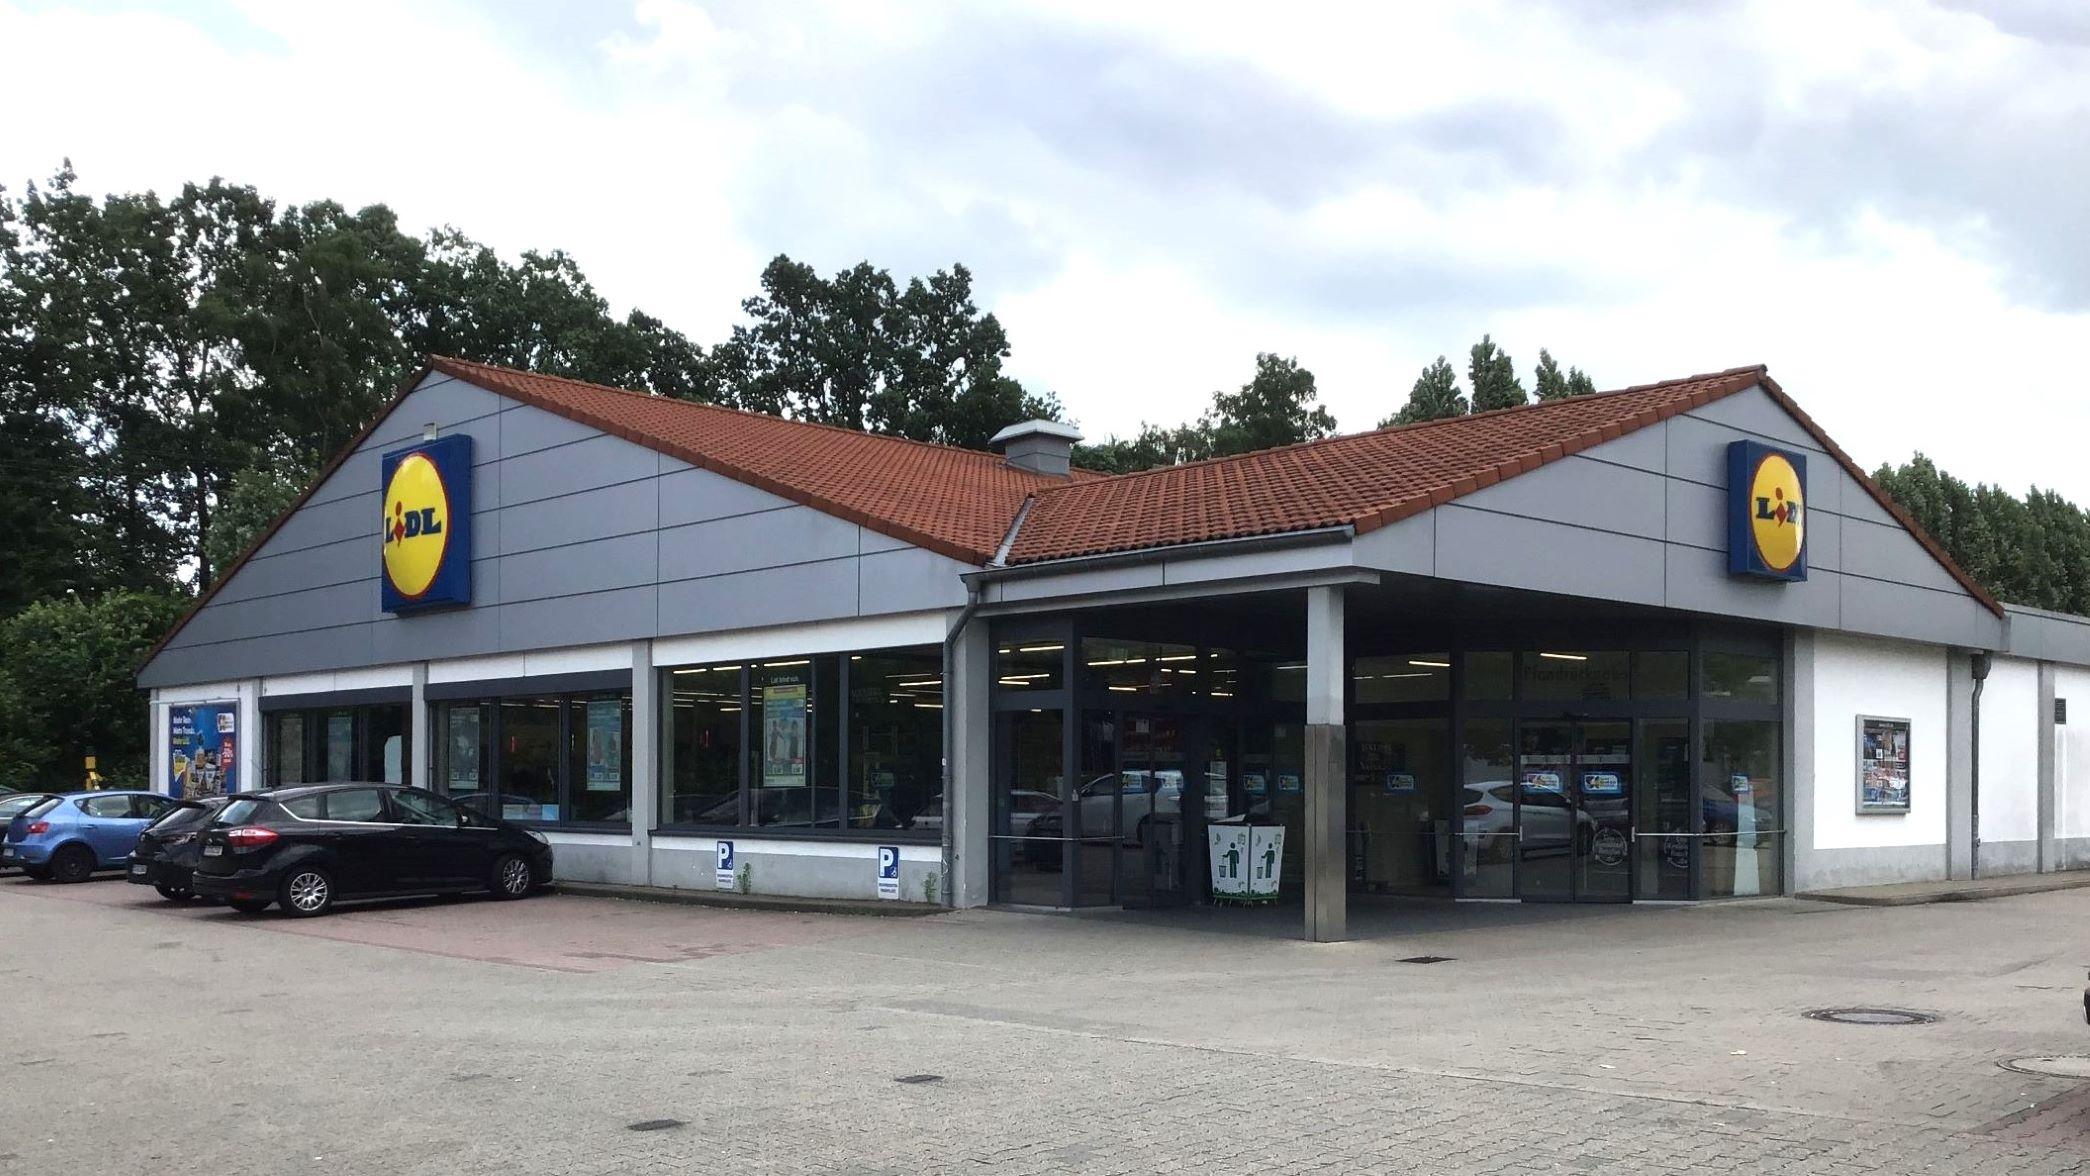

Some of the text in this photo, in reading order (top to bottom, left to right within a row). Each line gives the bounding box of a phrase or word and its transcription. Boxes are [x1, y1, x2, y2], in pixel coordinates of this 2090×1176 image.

[1755, 487, 1802, 528] LID
[718, 843, 730, 868] P
[880, 848, 894, 877] P
